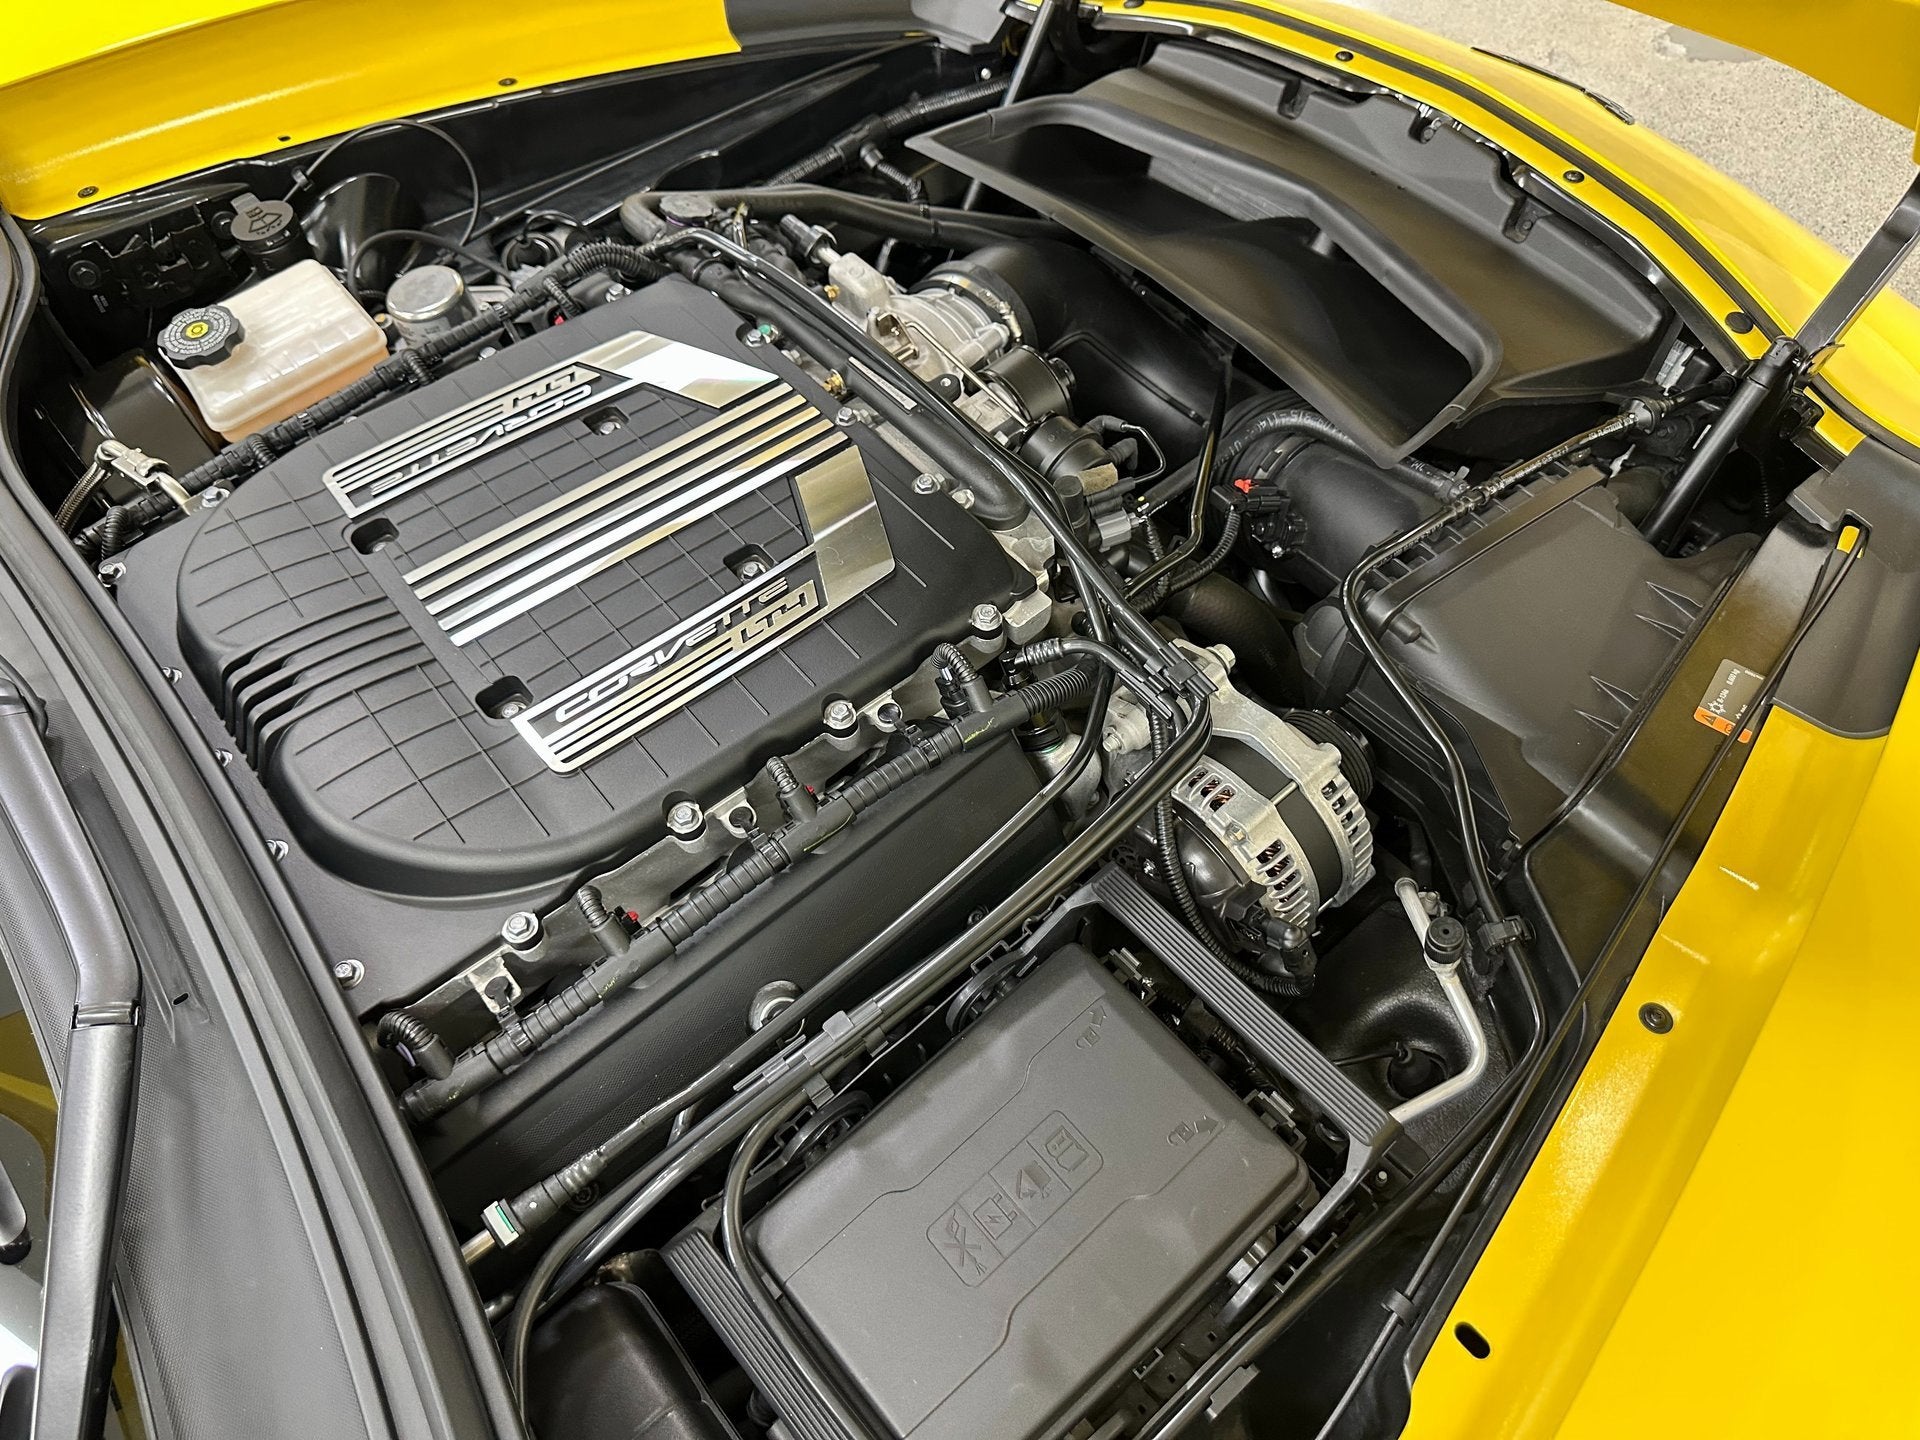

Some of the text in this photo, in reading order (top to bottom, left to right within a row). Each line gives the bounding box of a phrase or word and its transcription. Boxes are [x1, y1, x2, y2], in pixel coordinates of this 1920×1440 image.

[513, 371, 575, 408] LT4
[369, 384, 592, 496] CORVETTE
[555, 577, 788, 722] CORVETTE
[741, 592, 808, 643] LT4
